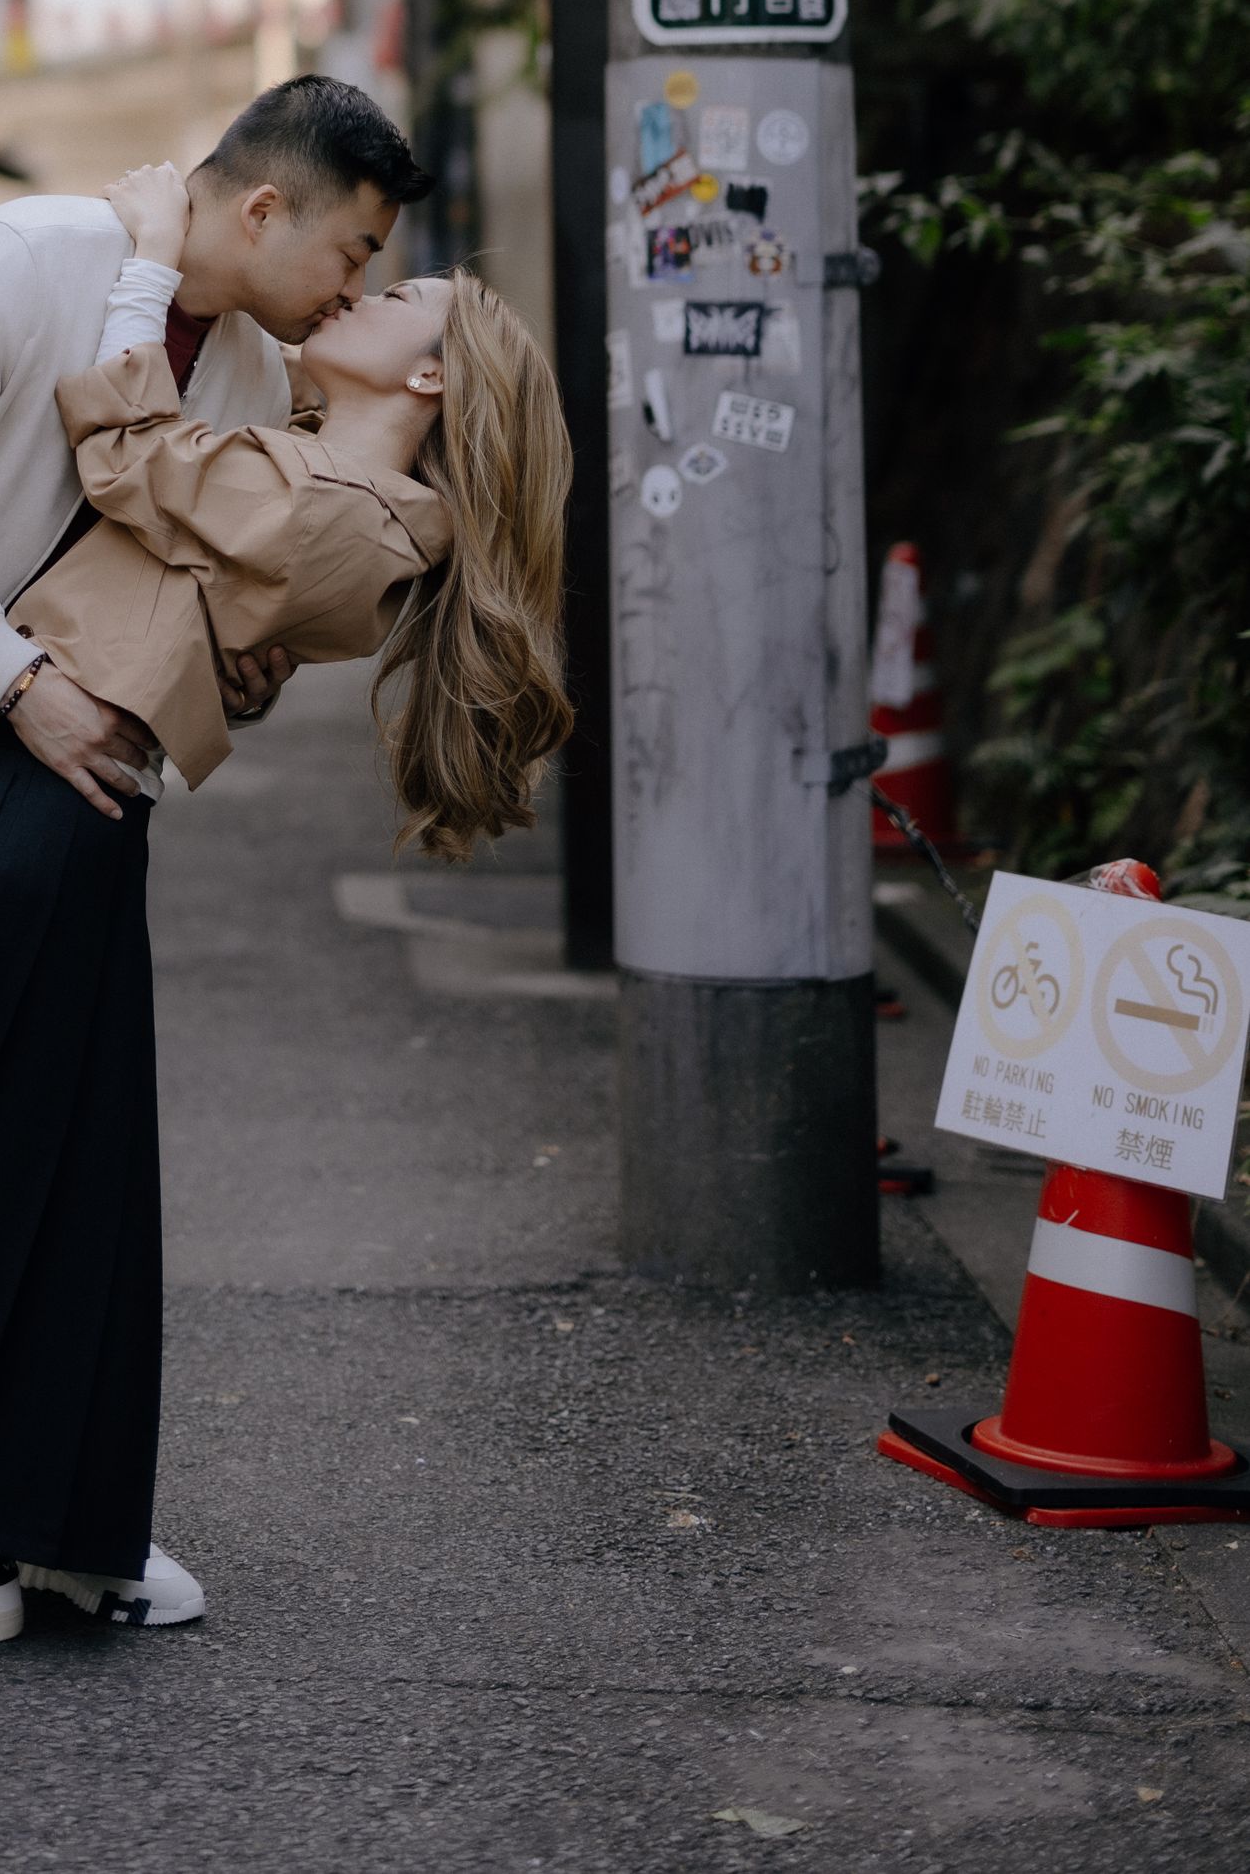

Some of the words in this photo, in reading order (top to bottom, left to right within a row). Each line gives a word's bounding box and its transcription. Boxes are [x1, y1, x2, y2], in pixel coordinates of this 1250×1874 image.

[973, 1054, 990, 1078] NO
[995, 1060, 1054, 1094] PARKING
[962, 1089, 1046, 1138] 駐輪禁止
[1092, 1084, 1114, 1108] NO
[1125, 1092, 1204, 1129] SMOKING
[1114, 1127, 1175, 1170] 禁煙
